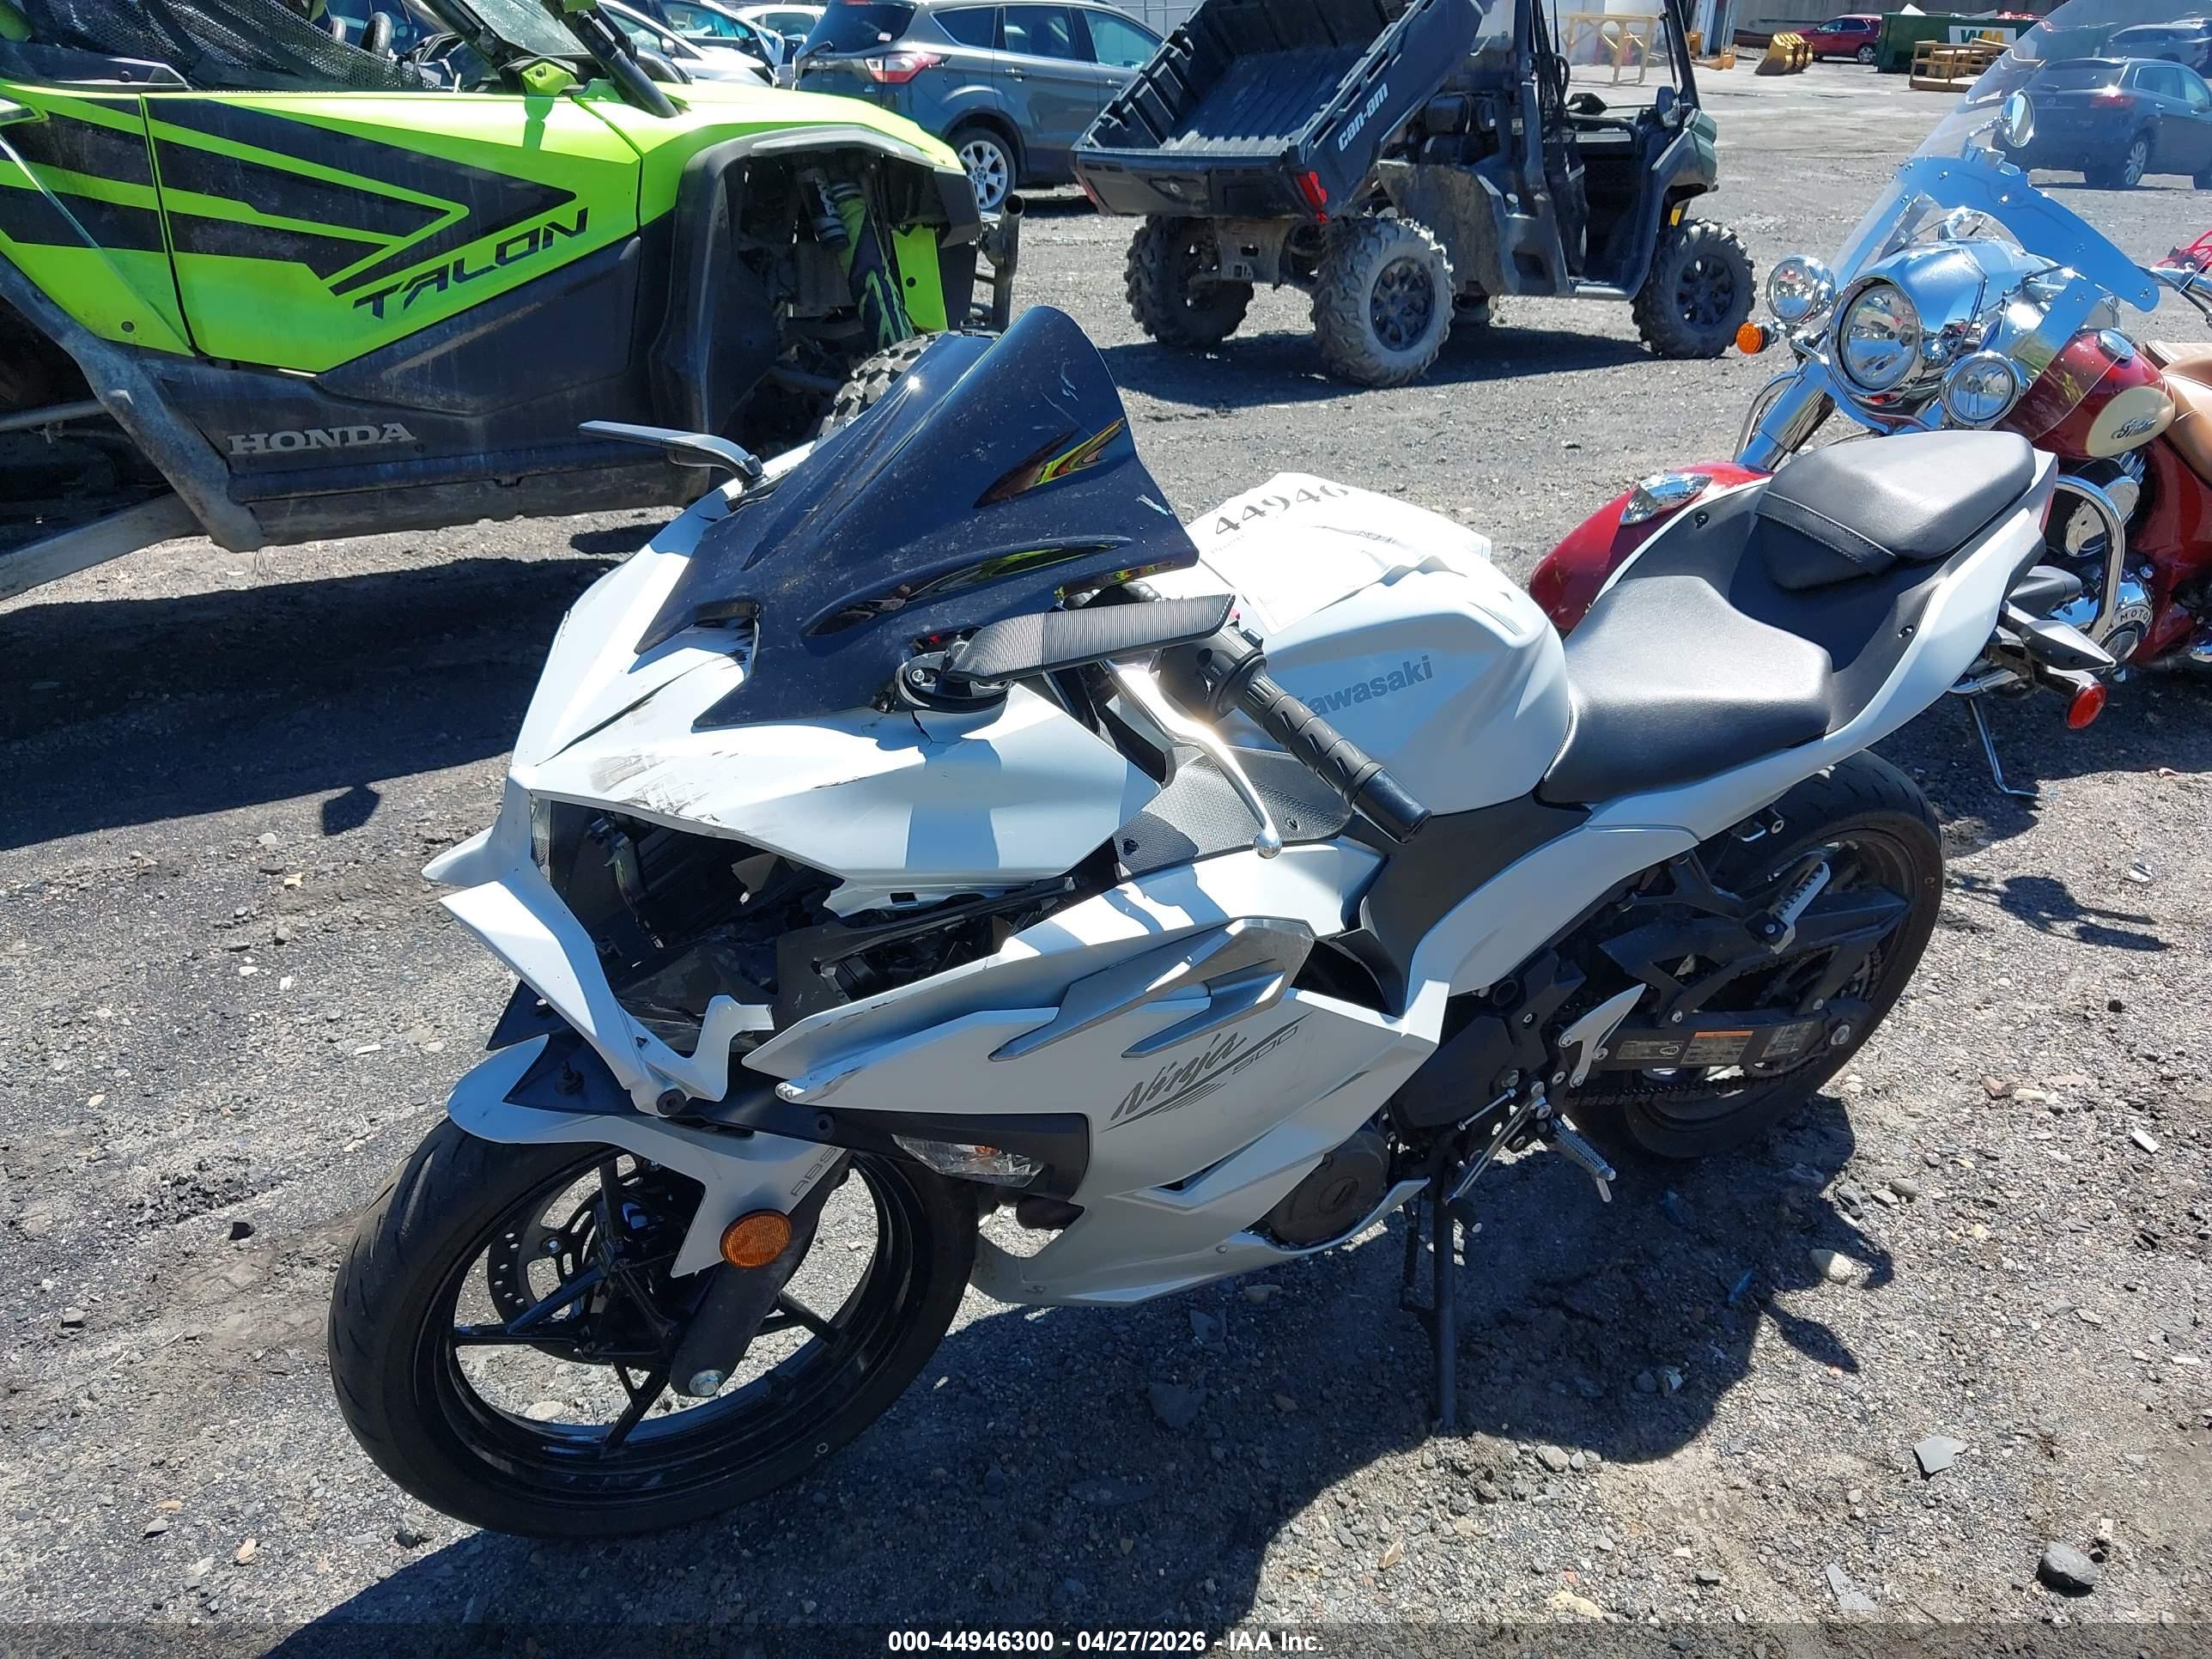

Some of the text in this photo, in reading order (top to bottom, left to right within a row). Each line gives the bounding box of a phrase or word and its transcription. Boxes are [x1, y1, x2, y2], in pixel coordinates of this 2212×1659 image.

[1338, 82, 1389, 151] can-am
[353, 207, 588, 319] TALON
[228, 422, 416, 455] HONDA
[1110, 1032, 1247, 1121] Ninja
[791, 1146, 837, 1196] ABS
